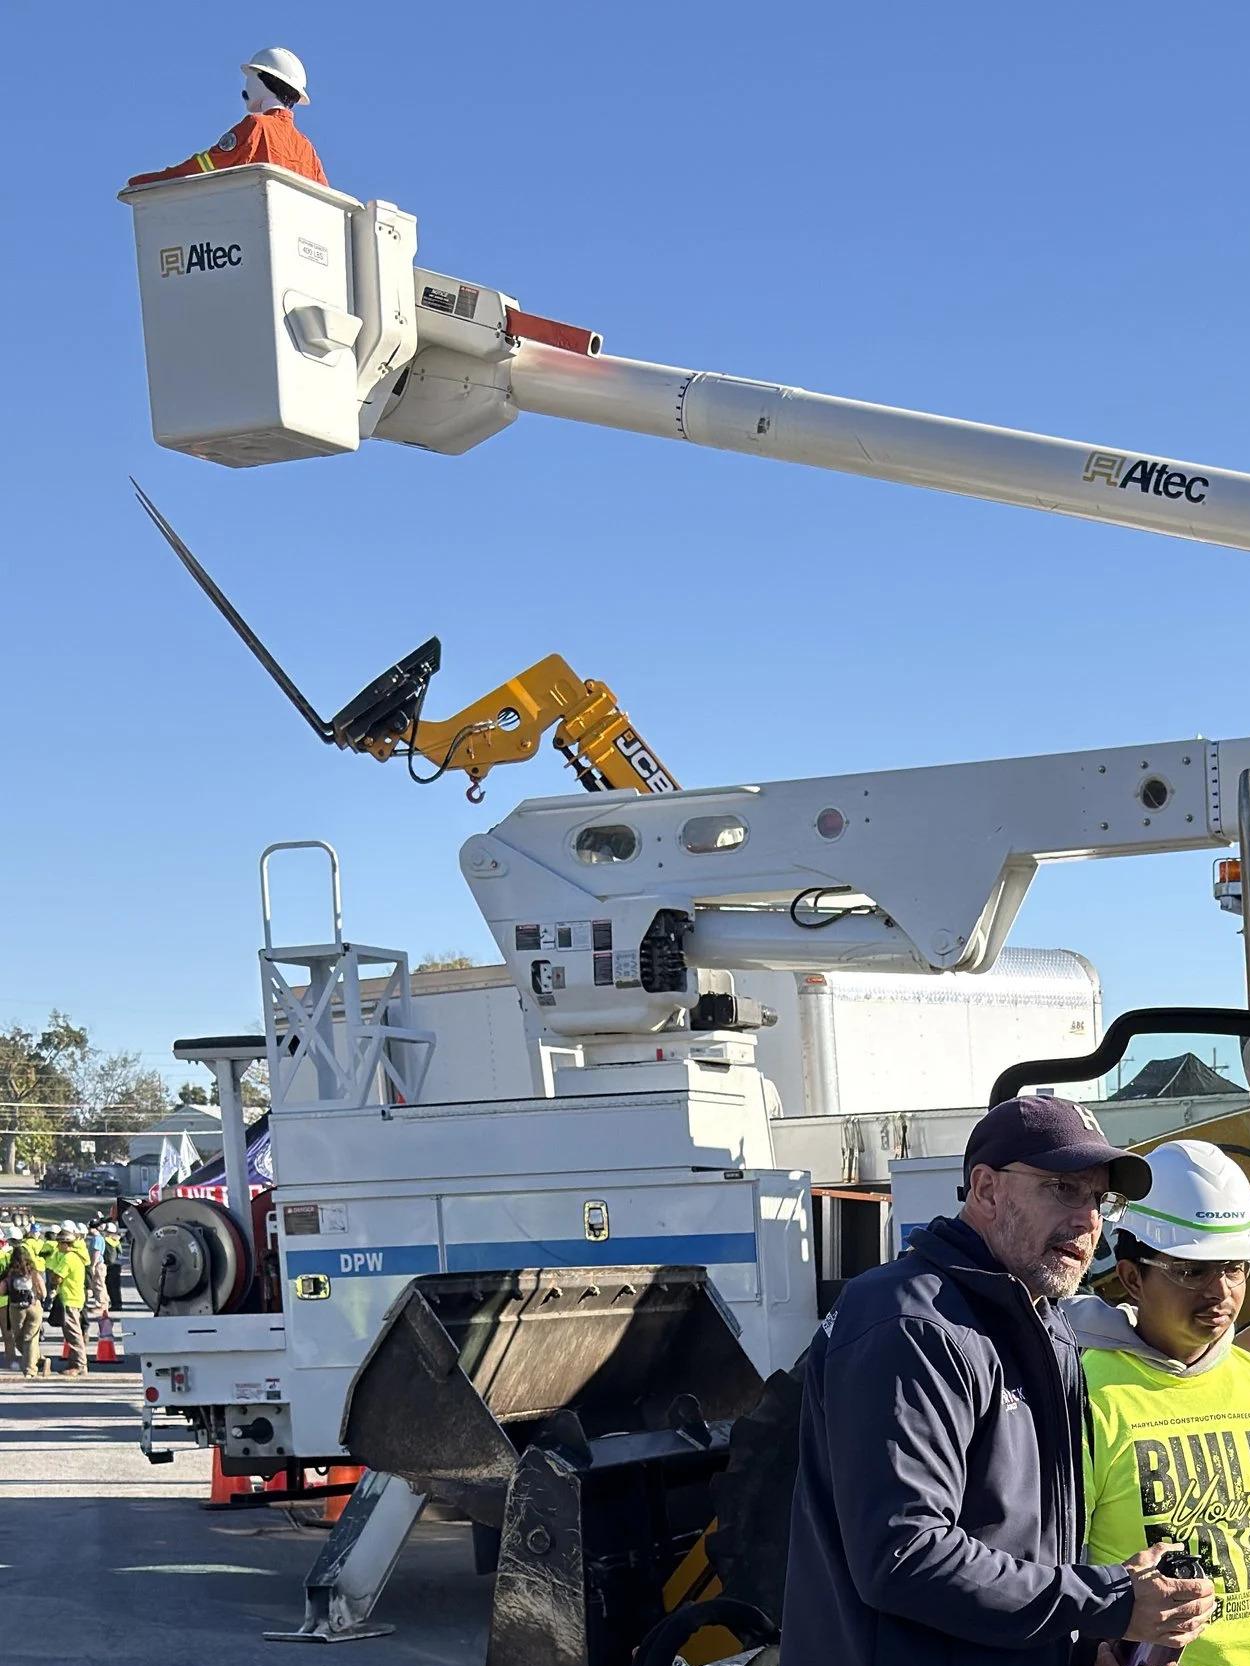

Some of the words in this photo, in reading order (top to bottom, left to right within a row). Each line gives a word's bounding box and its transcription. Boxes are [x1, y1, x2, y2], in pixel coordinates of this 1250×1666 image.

[186, 241, 243, 274] Altec
[1119, 459, 1210, 504] Altec
[1072, 1104, 1105, 1137] H
[293, 1206, 315, 1214] DANGER
[1195, 1211, 1246, 1219] COLONY
[340, 1252, 383, 1273] DPW
[1131, 1419, 1169, 1429] MARYLAND
[1170, 1413, 1227, 1425] CONSTRUCTION
